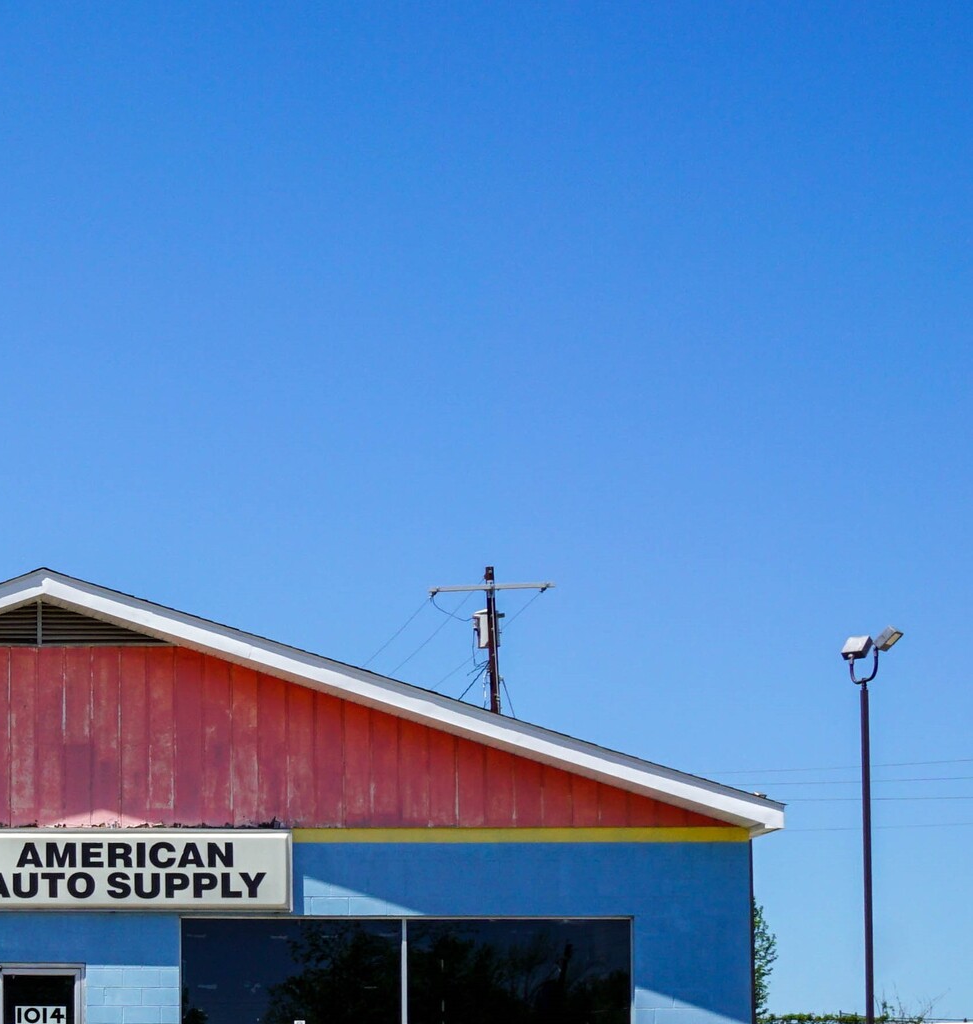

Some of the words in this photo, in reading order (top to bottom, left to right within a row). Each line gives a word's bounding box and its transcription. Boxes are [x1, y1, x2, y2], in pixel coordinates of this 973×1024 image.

[16, 842, 234, 868] AMERICAN
[106, 872, 267, 899] SUPPLY
[17, 1007, 65, 1023] 1014
